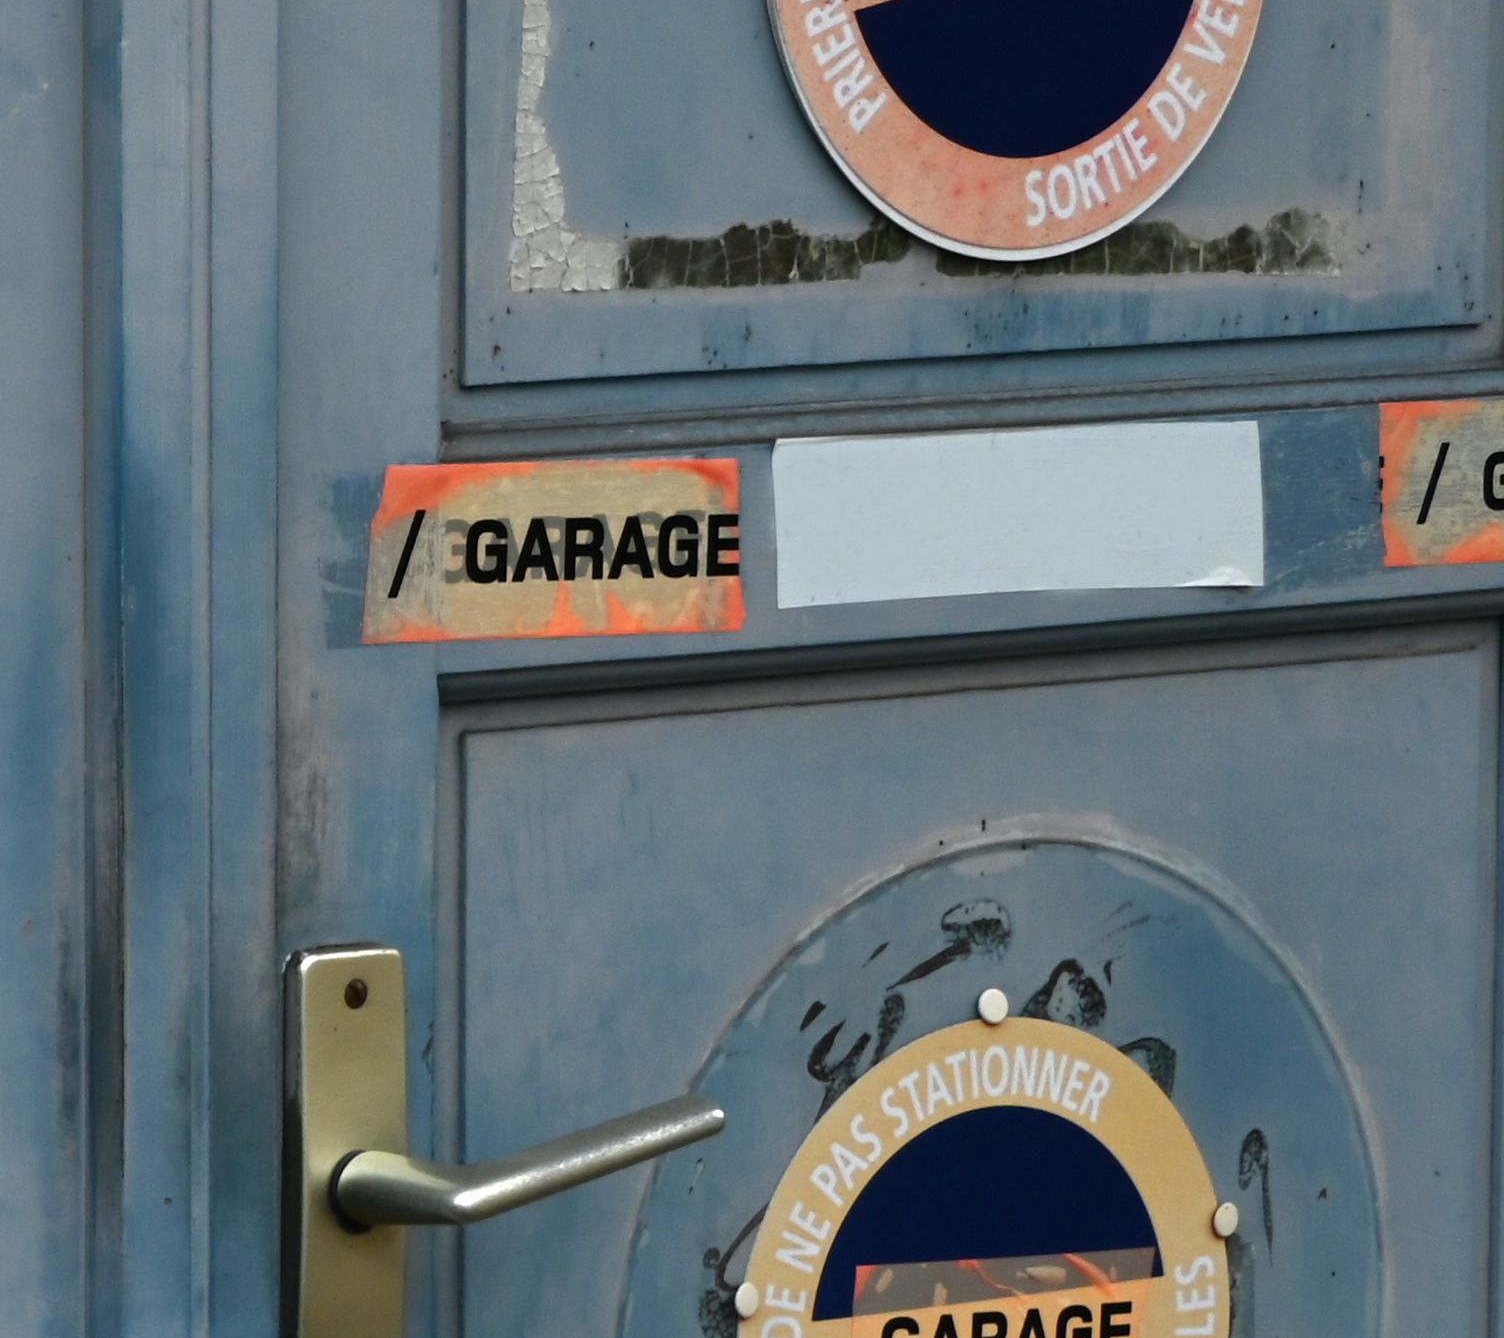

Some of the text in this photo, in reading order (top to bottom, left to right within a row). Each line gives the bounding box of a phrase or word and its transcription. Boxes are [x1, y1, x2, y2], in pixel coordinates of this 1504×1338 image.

[1025, 126, 1158, 228] SORTIE
[1149, 64, 1207, 142] DE
[464, 513, 740, 584] GARAGE
[774, 1202, 833, 1274] NE
[810, 1113, 885, 1208] PAS
[879, 1043, 1112, 1139] STATIONNER
